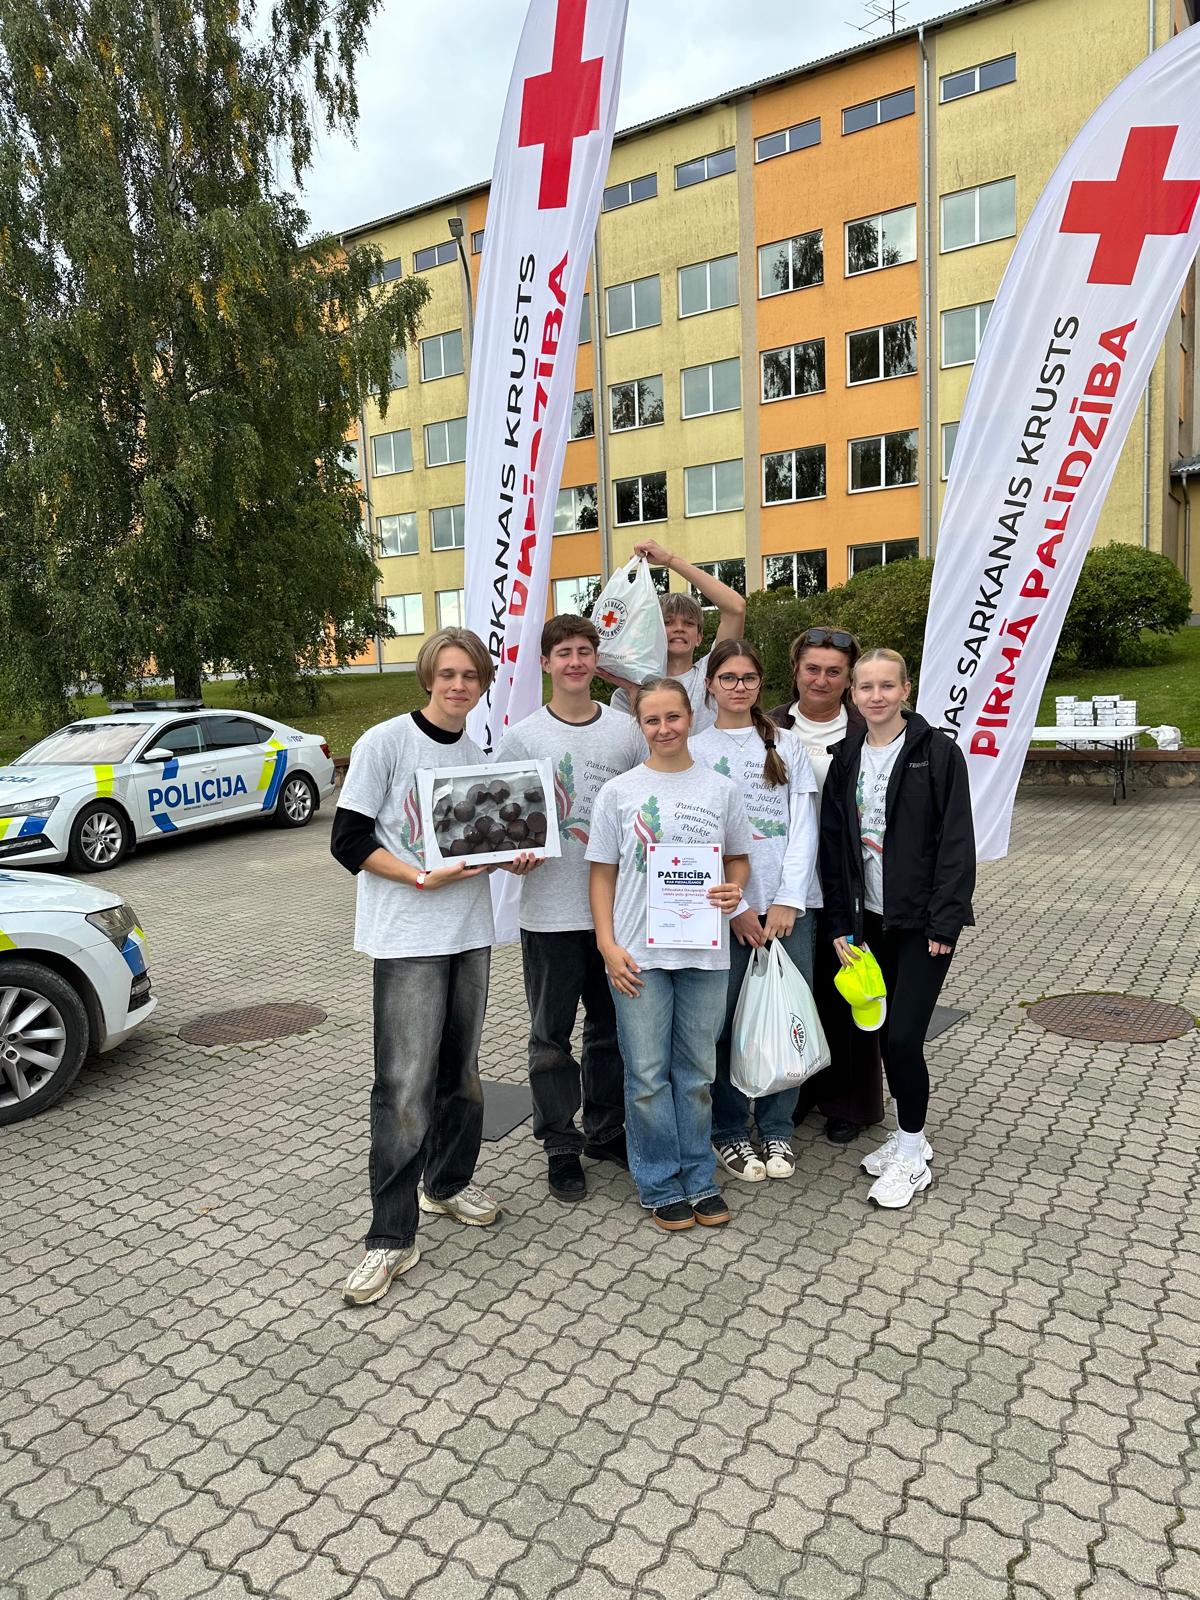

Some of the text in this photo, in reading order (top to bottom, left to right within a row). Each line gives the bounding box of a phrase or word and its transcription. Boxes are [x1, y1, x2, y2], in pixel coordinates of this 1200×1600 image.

[504, 253, 535, 448] KRUSTS
[957, 476, 1033, 678] SARKANAIS
[1016, 315, 1080, 466] KRUSTS
[969, 613, 1040, 758] PIRMĀ
[1019, 318, 1138, 599] PALĪDZĪBA
[147, 774, 248, 812] POLICIJA
[680, 823, 711, 837] Polskie
[657, 869, 712, 879] PATEICĪBA
